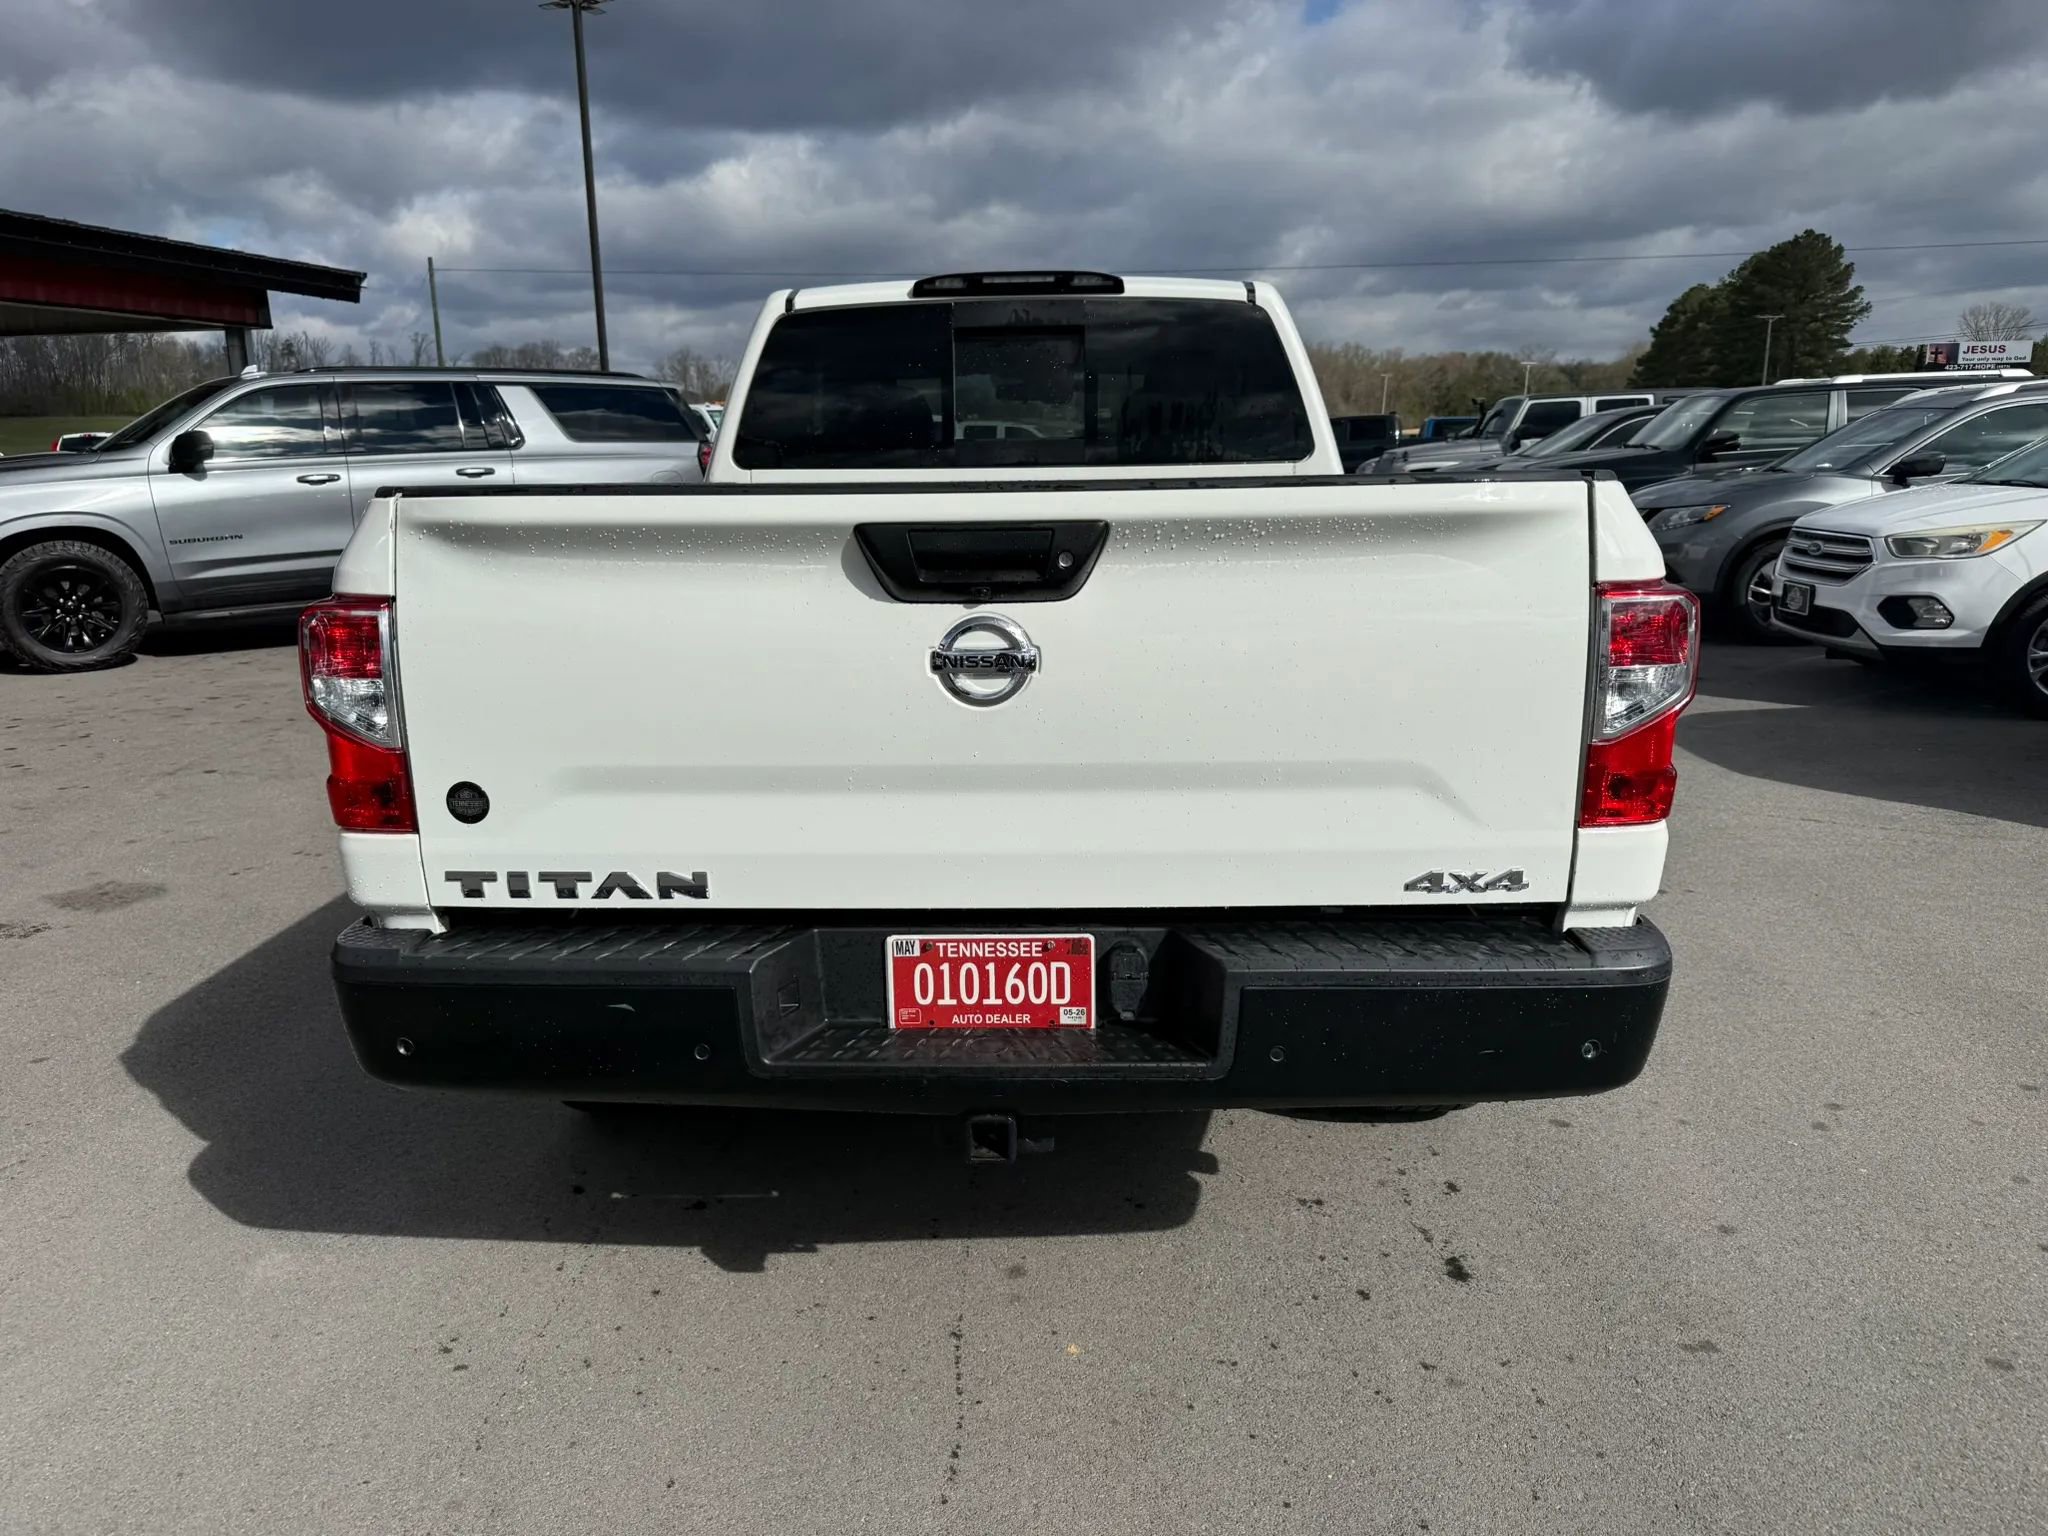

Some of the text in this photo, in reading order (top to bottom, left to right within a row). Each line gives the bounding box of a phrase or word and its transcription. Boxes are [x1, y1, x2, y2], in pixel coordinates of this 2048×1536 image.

[1962, 344, 2007, 354] JESUS
[169, 534, 243, 545] SUBURBAN
[942, 654, 1026, 669] NISSAN
[444, 870, 711, 900] TITAN
[895, 940, 916, 956] MAY
[935, 941, 1043, 958] TENNESSEE
[913, 960, 1071, 1006] 010160D
[951, 1013, 1031, 1025] AUTO DEALER
[1063, 1008, 1086, 1016] 05-26
